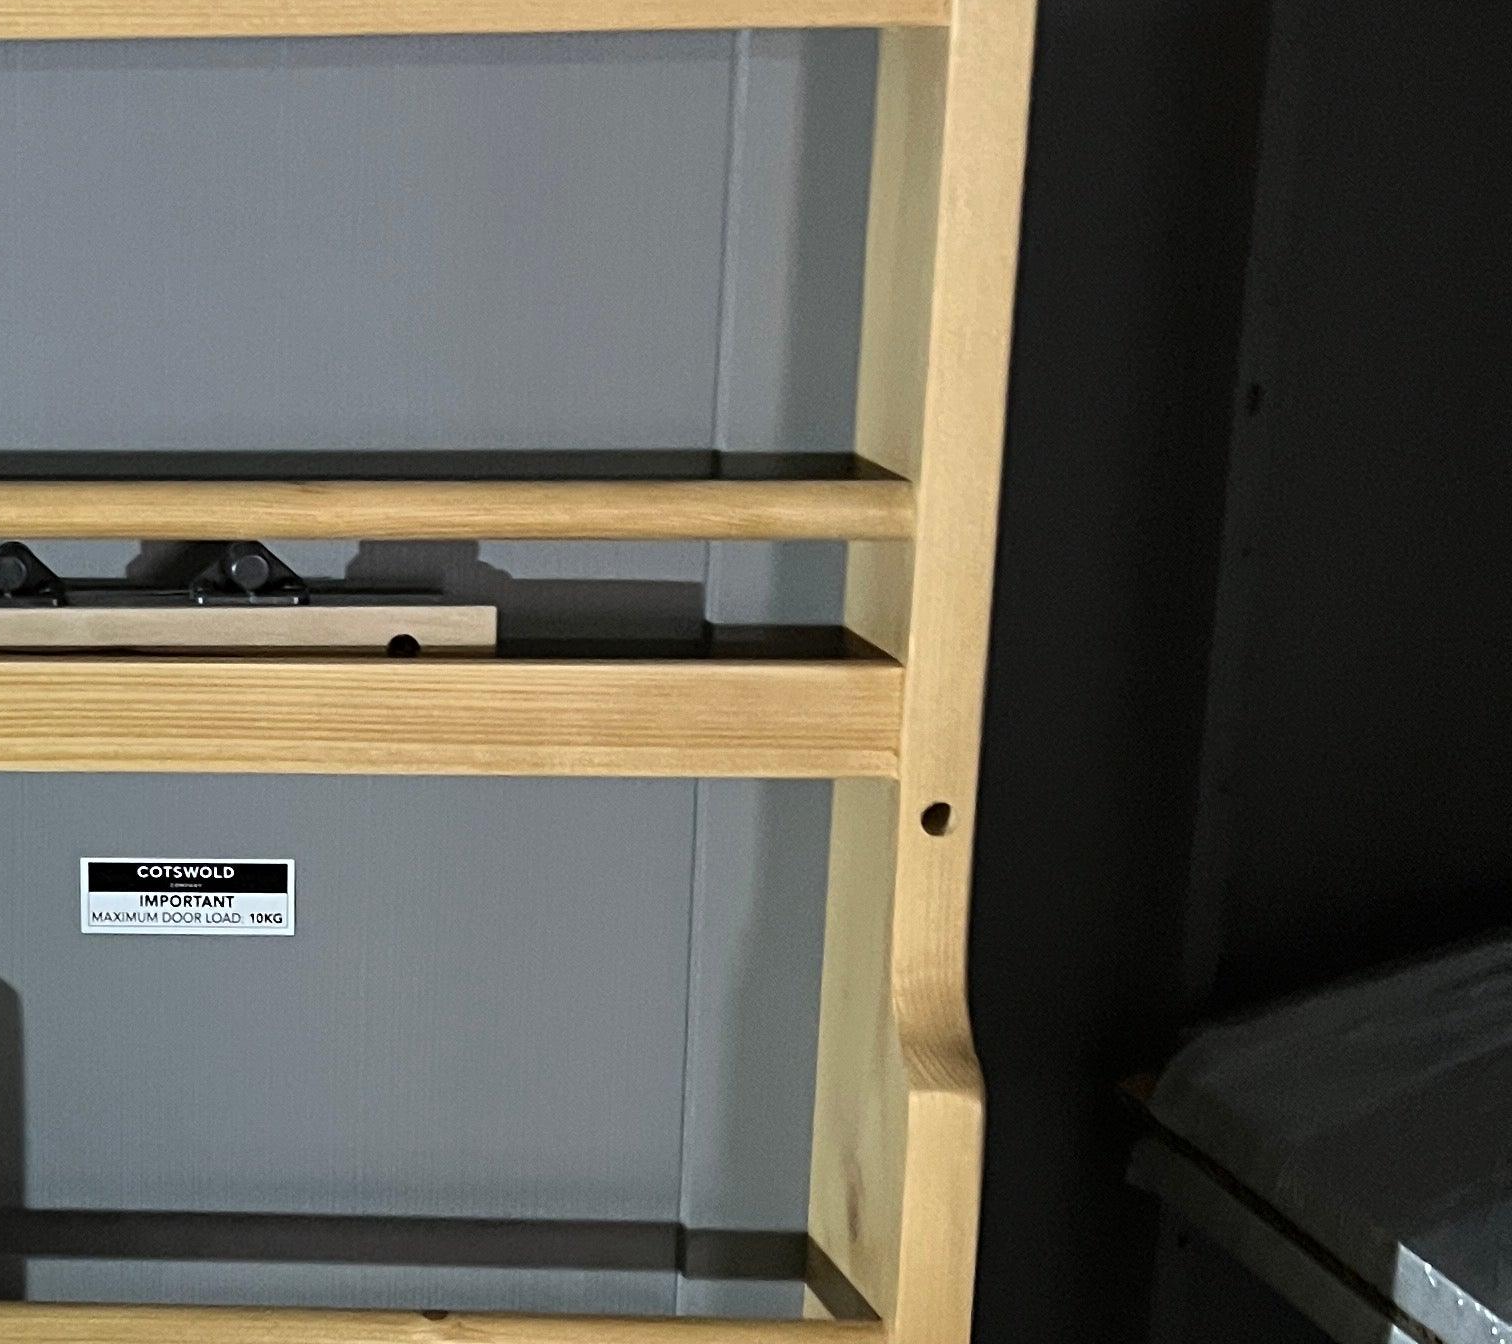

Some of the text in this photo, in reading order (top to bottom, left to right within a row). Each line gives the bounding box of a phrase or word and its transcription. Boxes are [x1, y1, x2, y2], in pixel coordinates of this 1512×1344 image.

[136, 865, 235, 879] COTSWOLD
[139, 894, 235, 908] IMPORTANT
[91, 911, 159, 923] MAXIMUM
[162, 912, 202, 924] DOOR
[249, 912, 283, 924] 10KG
